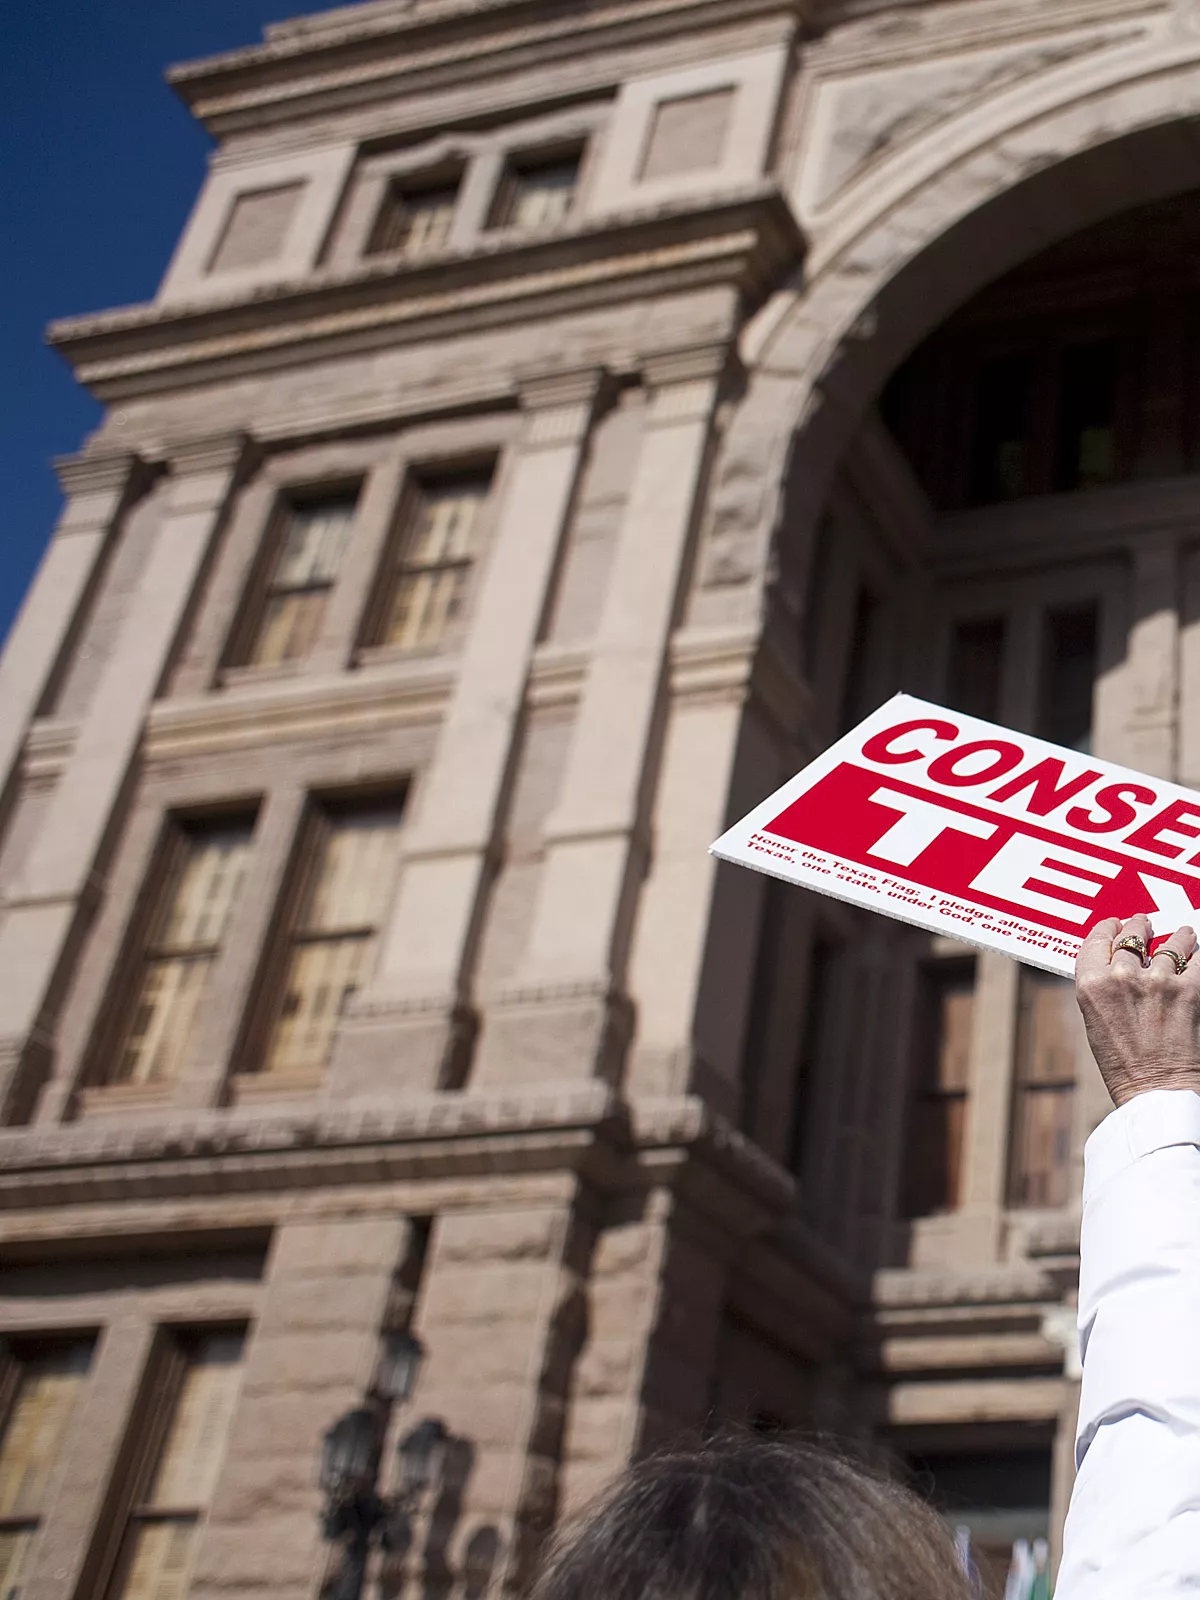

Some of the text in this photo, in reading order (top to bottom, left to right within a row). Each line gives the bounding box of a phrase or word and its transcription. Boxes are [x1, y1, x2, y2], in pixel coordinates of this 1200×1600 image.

[747, 841, 1078, 959] Texas, one state, under God, one and ind
[750, 833, 799, 853] Honor
[801, 851, 827, 863] the
[832, 860, 877, 881] Texas
[881, 878, 921, 896] Flag:
[938, 899, 994, 920] pledge
[998, 919, 1082, 950] allegiance
